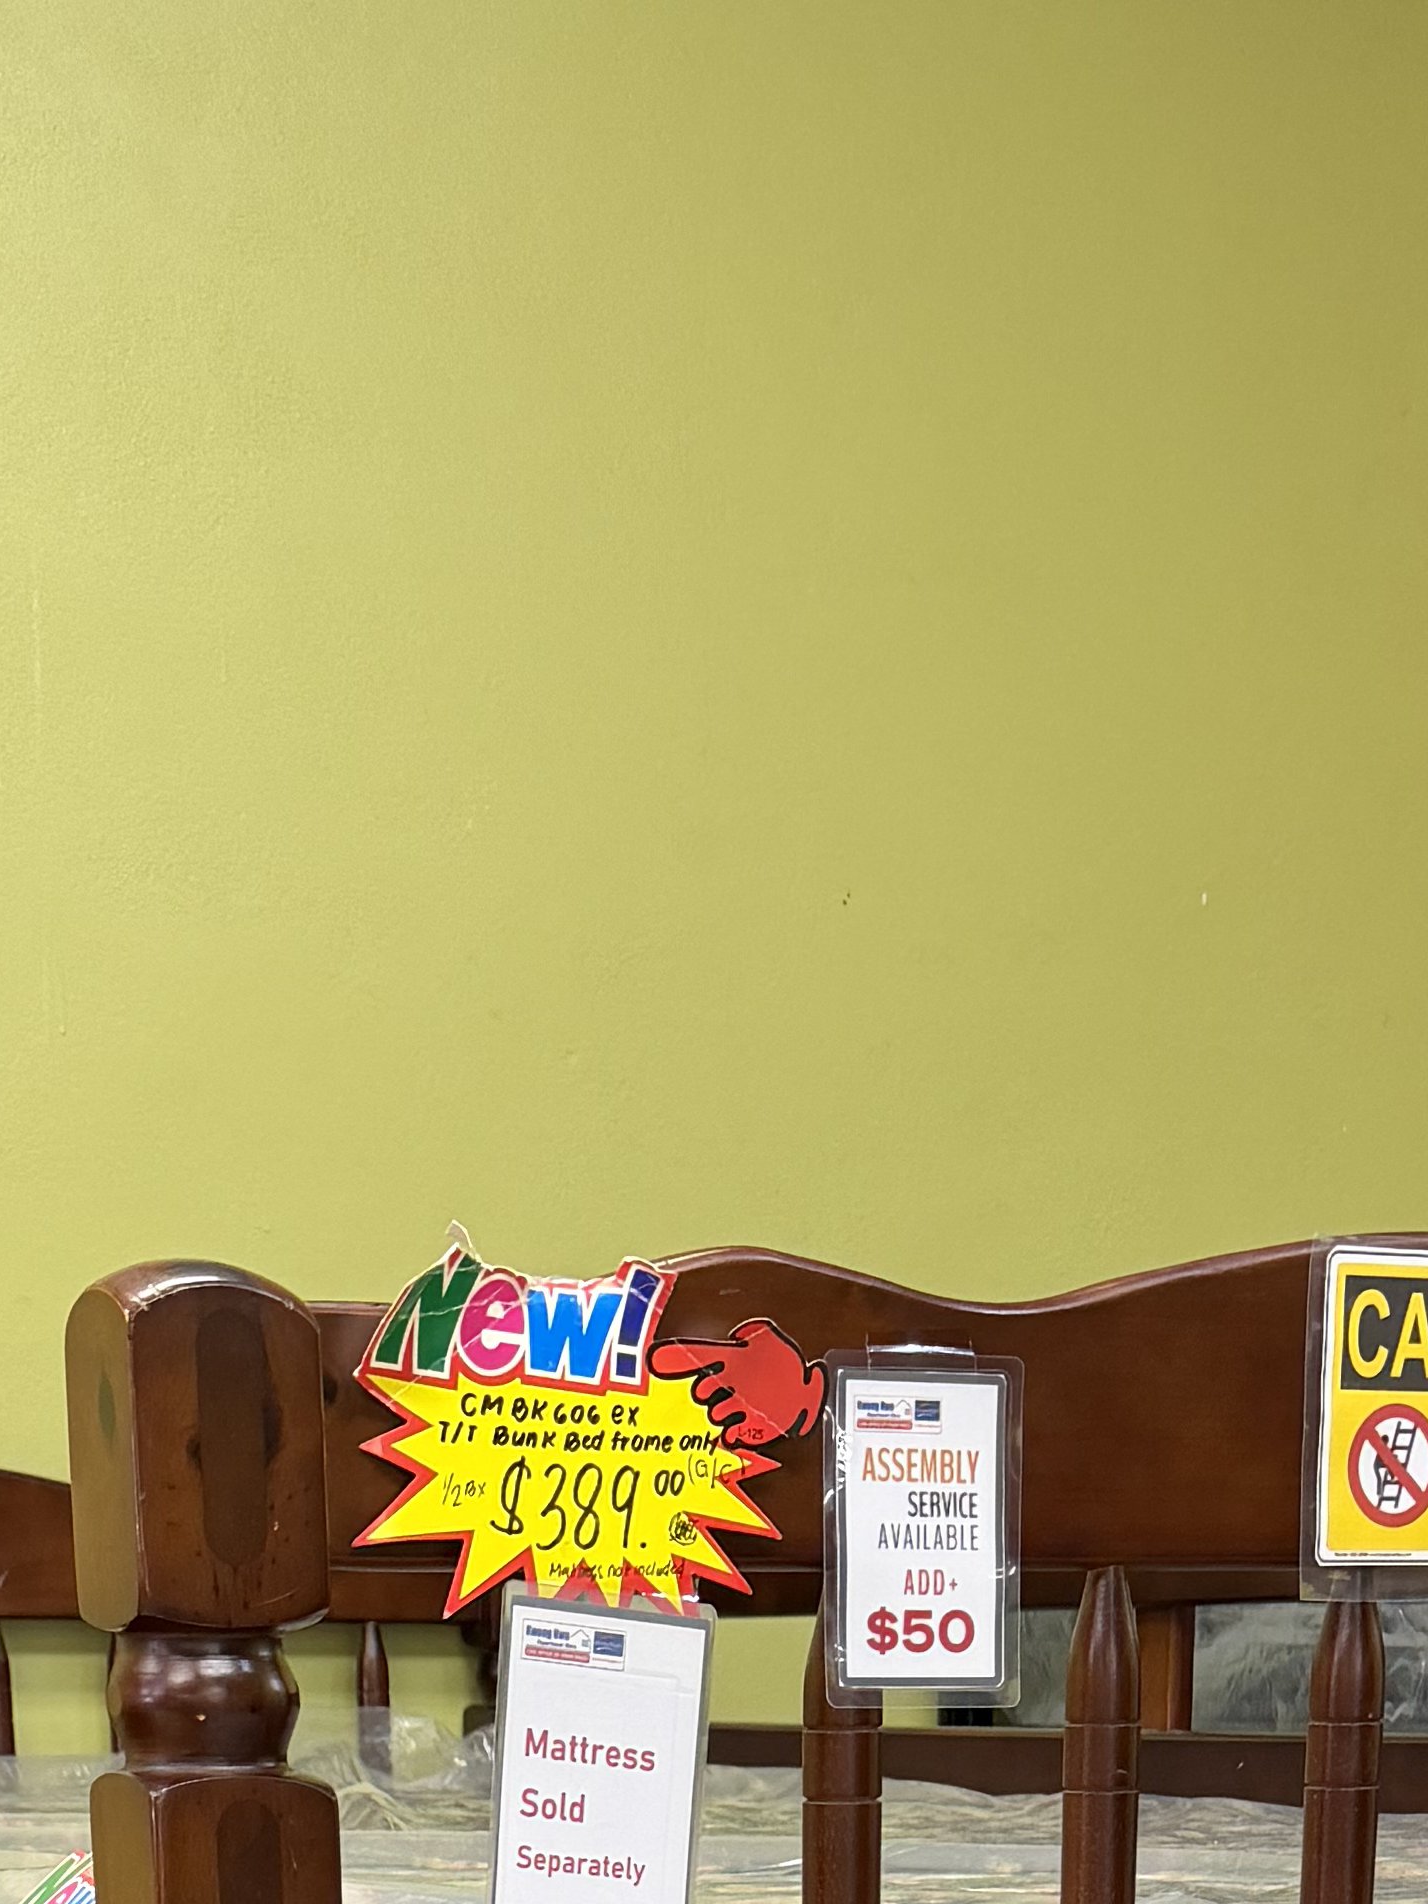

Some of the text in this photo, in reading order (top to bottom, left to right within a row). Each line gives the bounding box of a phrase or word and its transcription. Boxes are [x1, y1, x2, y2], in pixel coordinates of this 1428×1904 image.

[371, 1250, 664, 1385] New!
[438, 1421, 478, 1444] T/T
[563, 1430, 606, 1453] Bed
[679, 1431, 721, 1456] only
[862, 1447, 980, 1484] ASSEMBLY
[907, 1490, 979, 1519] SERVICE
[877, 1523, 980, 1551] AVAILABLE
[866, 1606, 975, 1656] $50
[525, 1727, 656, 1772] Mattress
[519, 1787, 586, 1824] Sold
[516, 1844, 646, 1887] Separately
